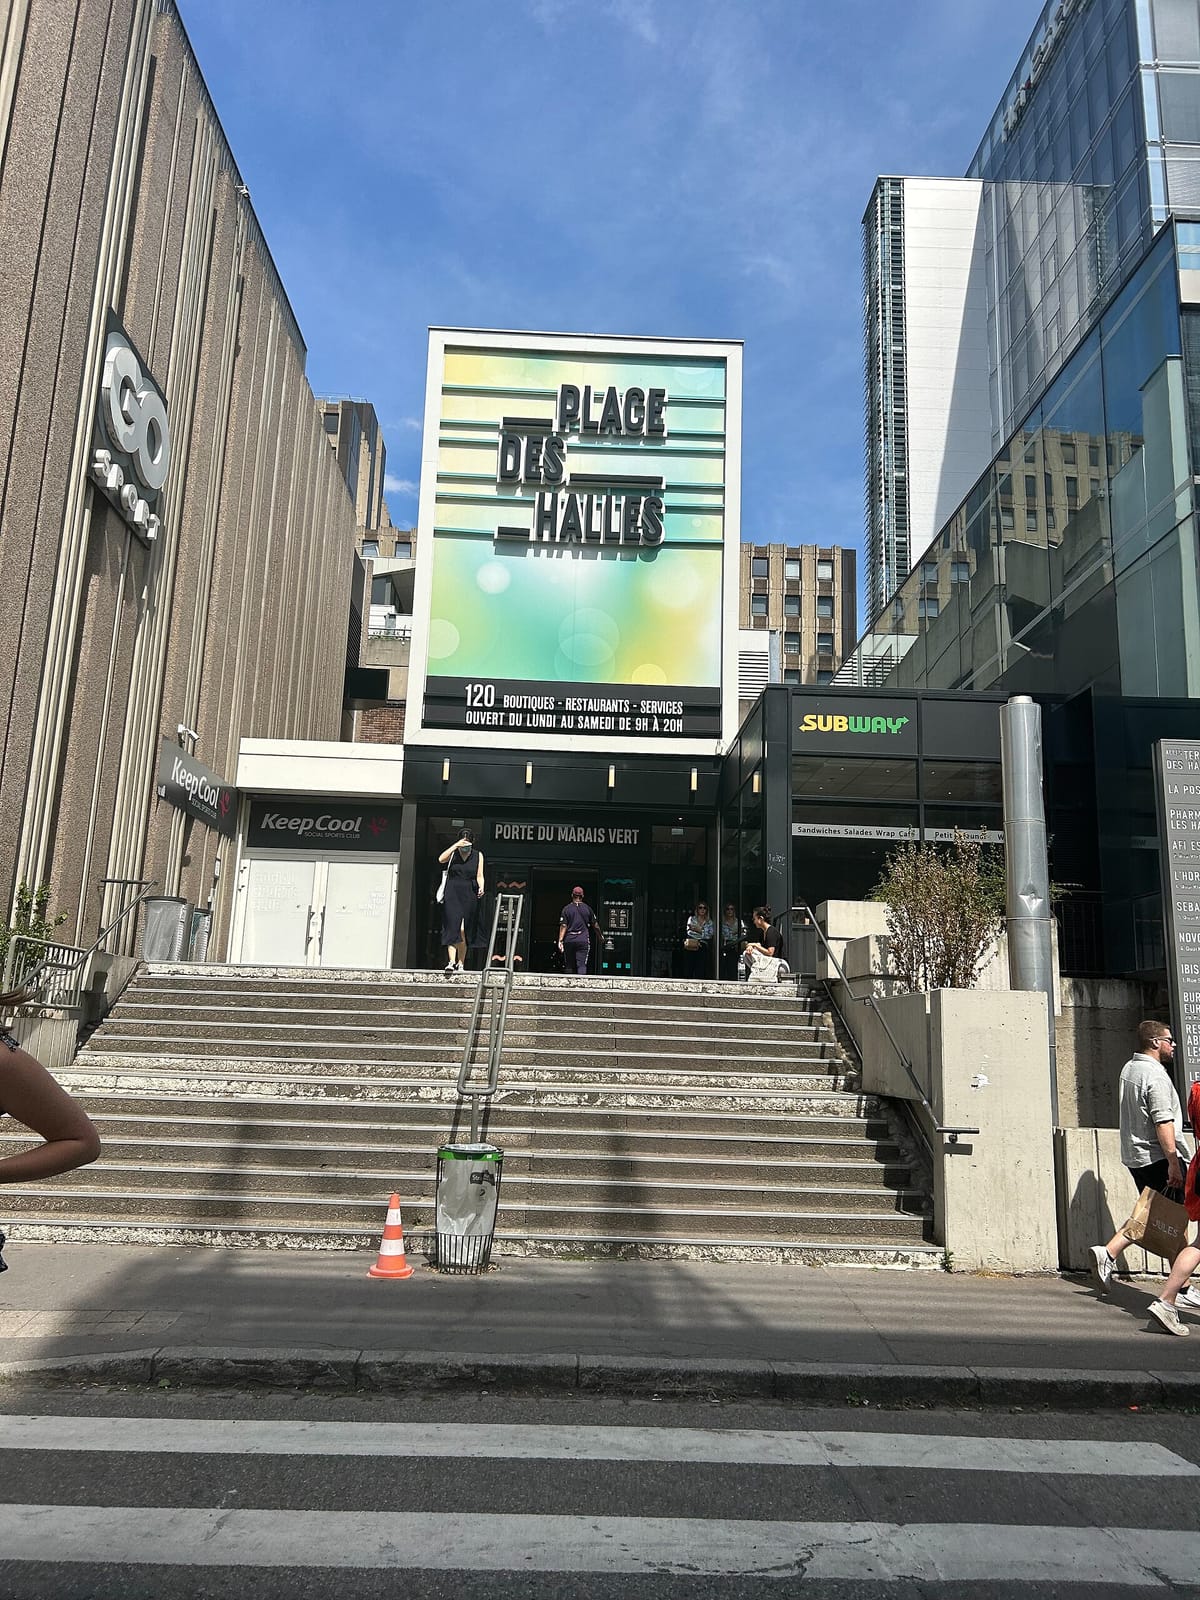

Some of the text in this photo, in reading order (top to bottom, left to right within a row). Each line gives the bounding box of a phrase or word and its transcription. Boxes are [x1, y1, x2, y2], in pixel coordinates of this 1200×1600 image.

[102, 346, 170, 490] GO
[499, 433, 565, 484] DES
[536, 492, 665, 543] HALLES
[465, 683, 495, 707] 120
[503, 694, 555, 711] BOUTIQUES
[565, 697, 630, 713] RESTAURANTS
[640, 700, 683, 715] SERVICES
[465, 710, 683, 733] OUVERT DU LUNDI AU SAMEDI DE 9H À 20H
[799, 714, 910, 734] SUBWAY
[1166, 760, 1183, 770] DES
[1168, 784, 1179, 794] LA
[797, 826, 841, 835] Sandwiches
[844, 828, 873, 836] Salades
[876, 829, 896, 838] Wrap
[1170, 820, 1187, 830] LES
[495, 823, 640, 845] PORTE DU MARAIS VERT
[1172, 840, 1187, 850] AFI
[1176, 901, 1200, 912] SEBA
[1181, 963, 1200, 975] IBIS
[1183, 991, 1200, 1003] BUR
[1152, 1219, 1179, 1238] JULES
